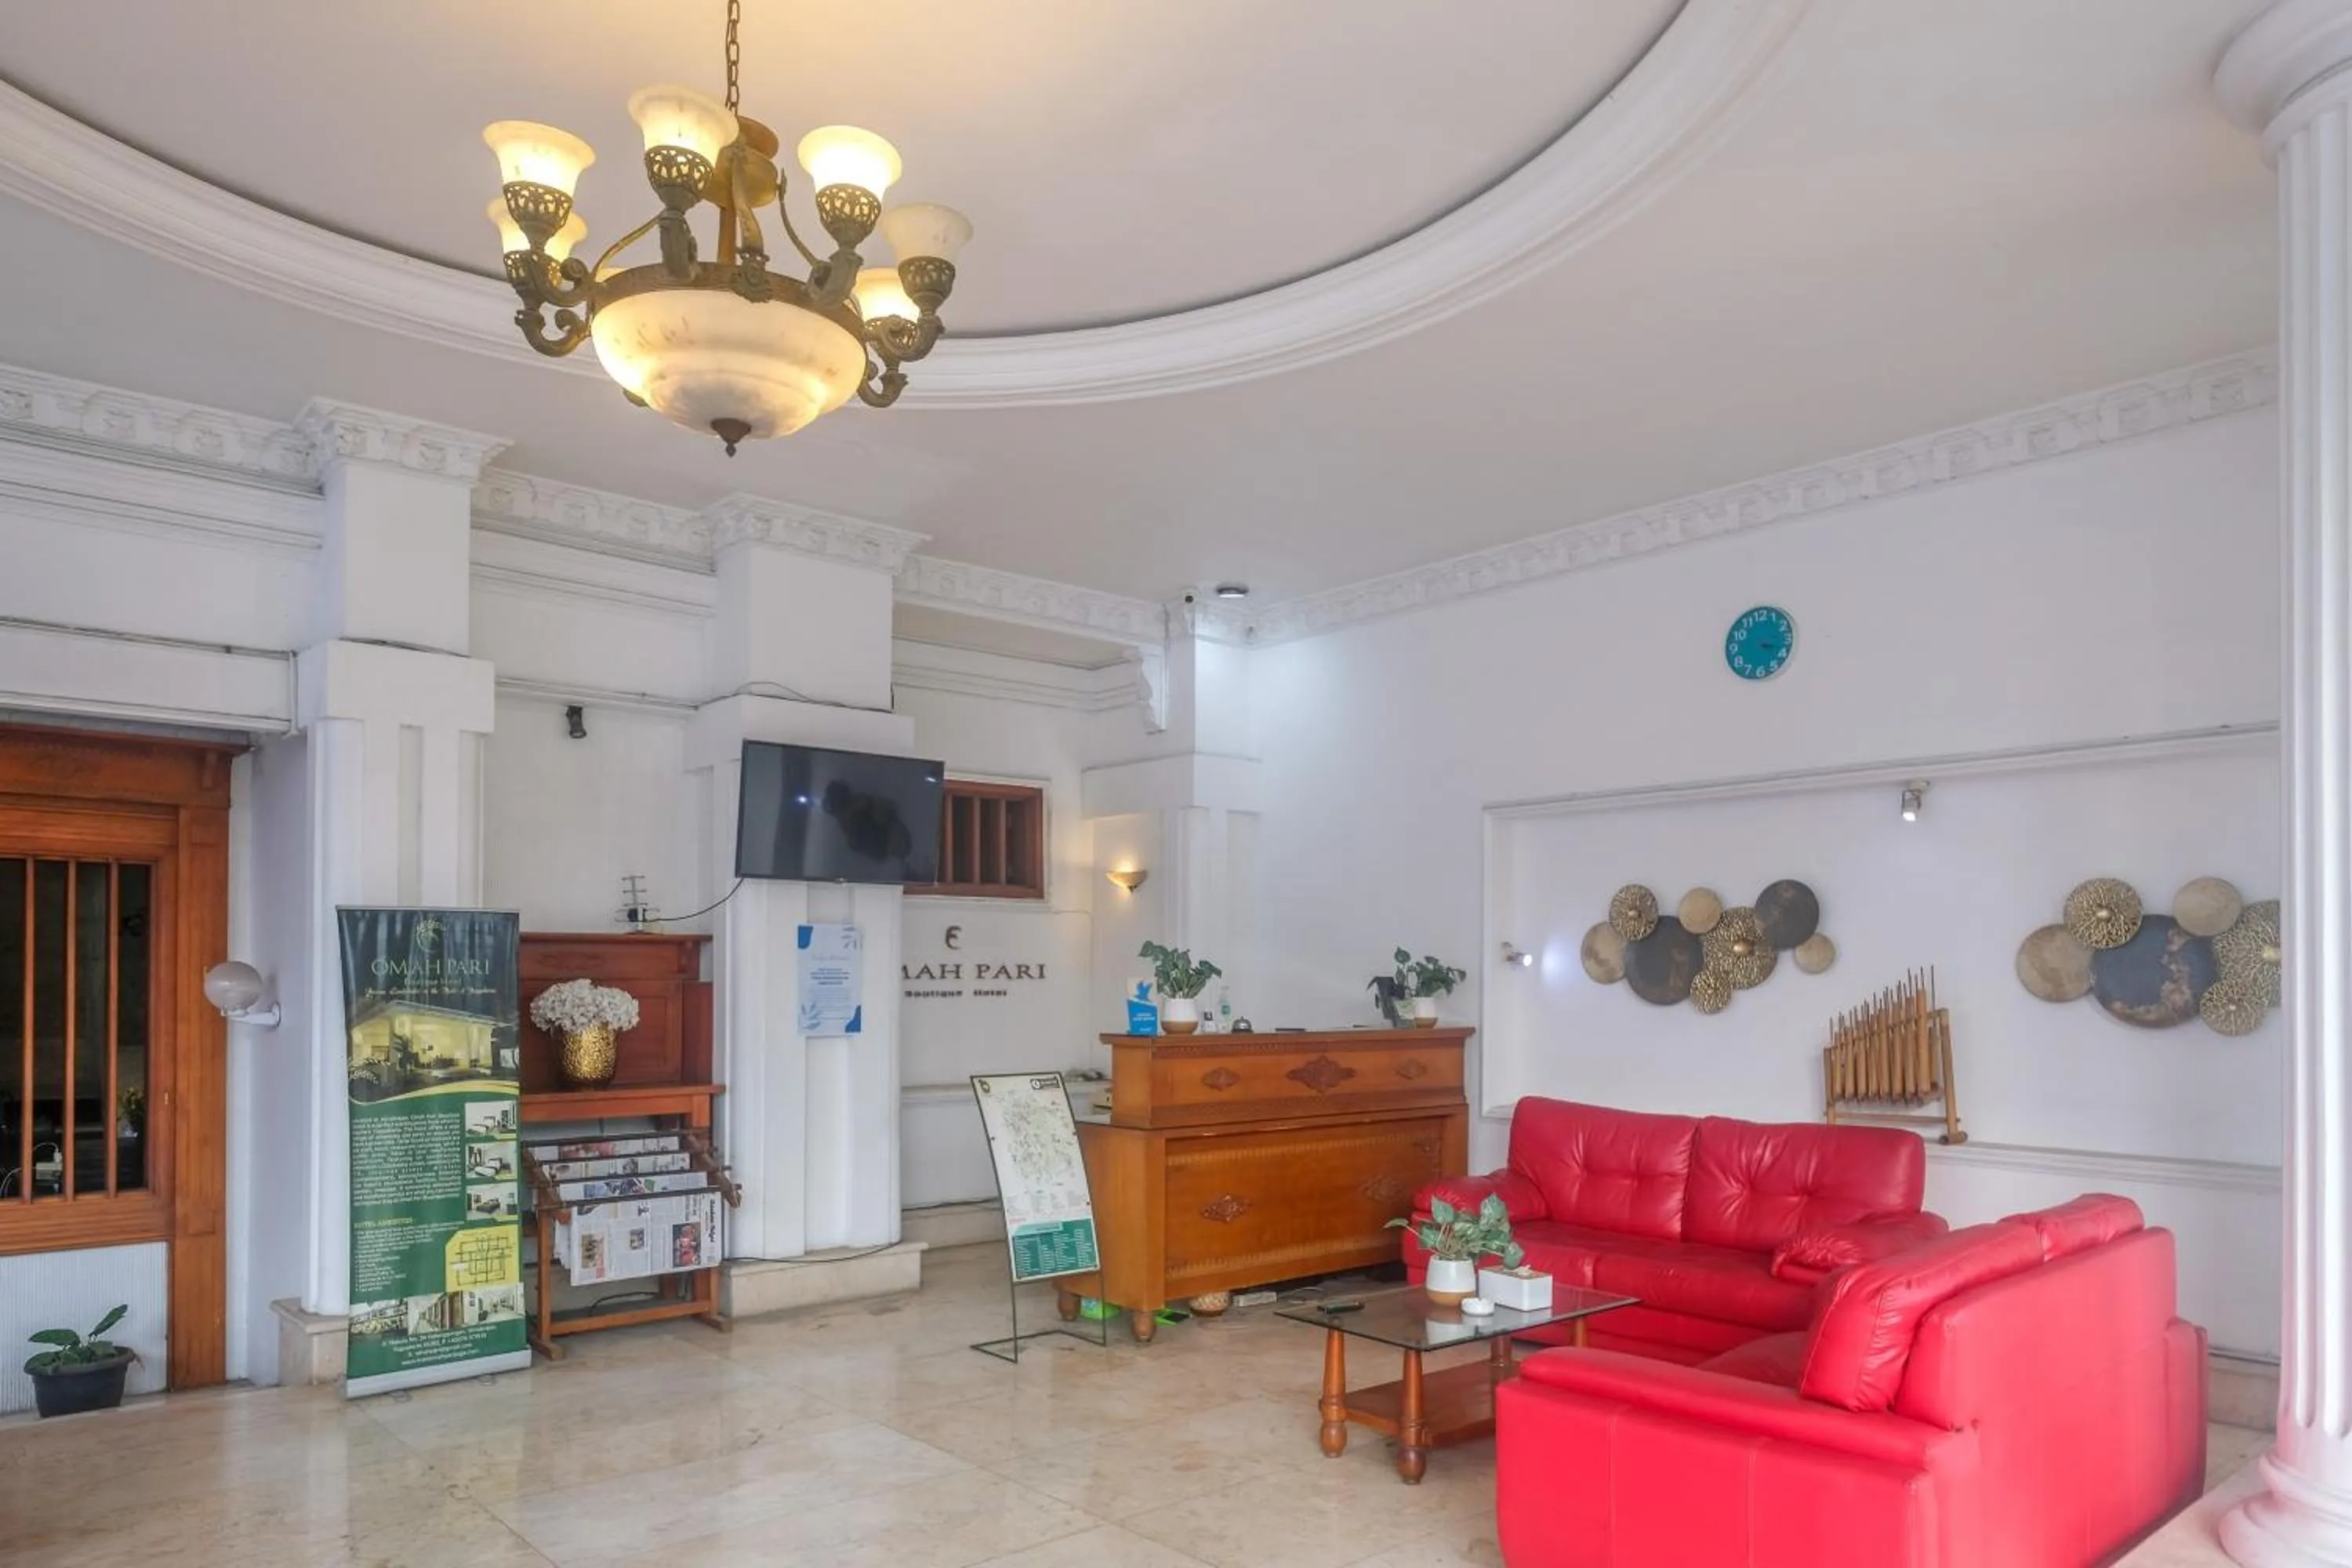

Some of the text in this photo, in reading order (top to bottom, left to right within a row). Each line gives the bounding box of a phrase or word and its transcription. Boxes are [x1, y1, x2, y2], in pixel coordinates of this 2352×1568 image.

[1753, 610, 1767, 622] 12
[1742, 617, 1753, 628] 11
[1778, 620, 1787, 633] 2
[1733, 630, 1748, 641] 10
[1729, 643, 1738, 655] 9
[1777, 648, 1787, 658] 4
[1744, 664, 1752, 675] 7
[1756, 666, 1766, 677] 6
[371, 958, 490, 976] OMAH PARI
[975, 964, 1047, 980] PARI
